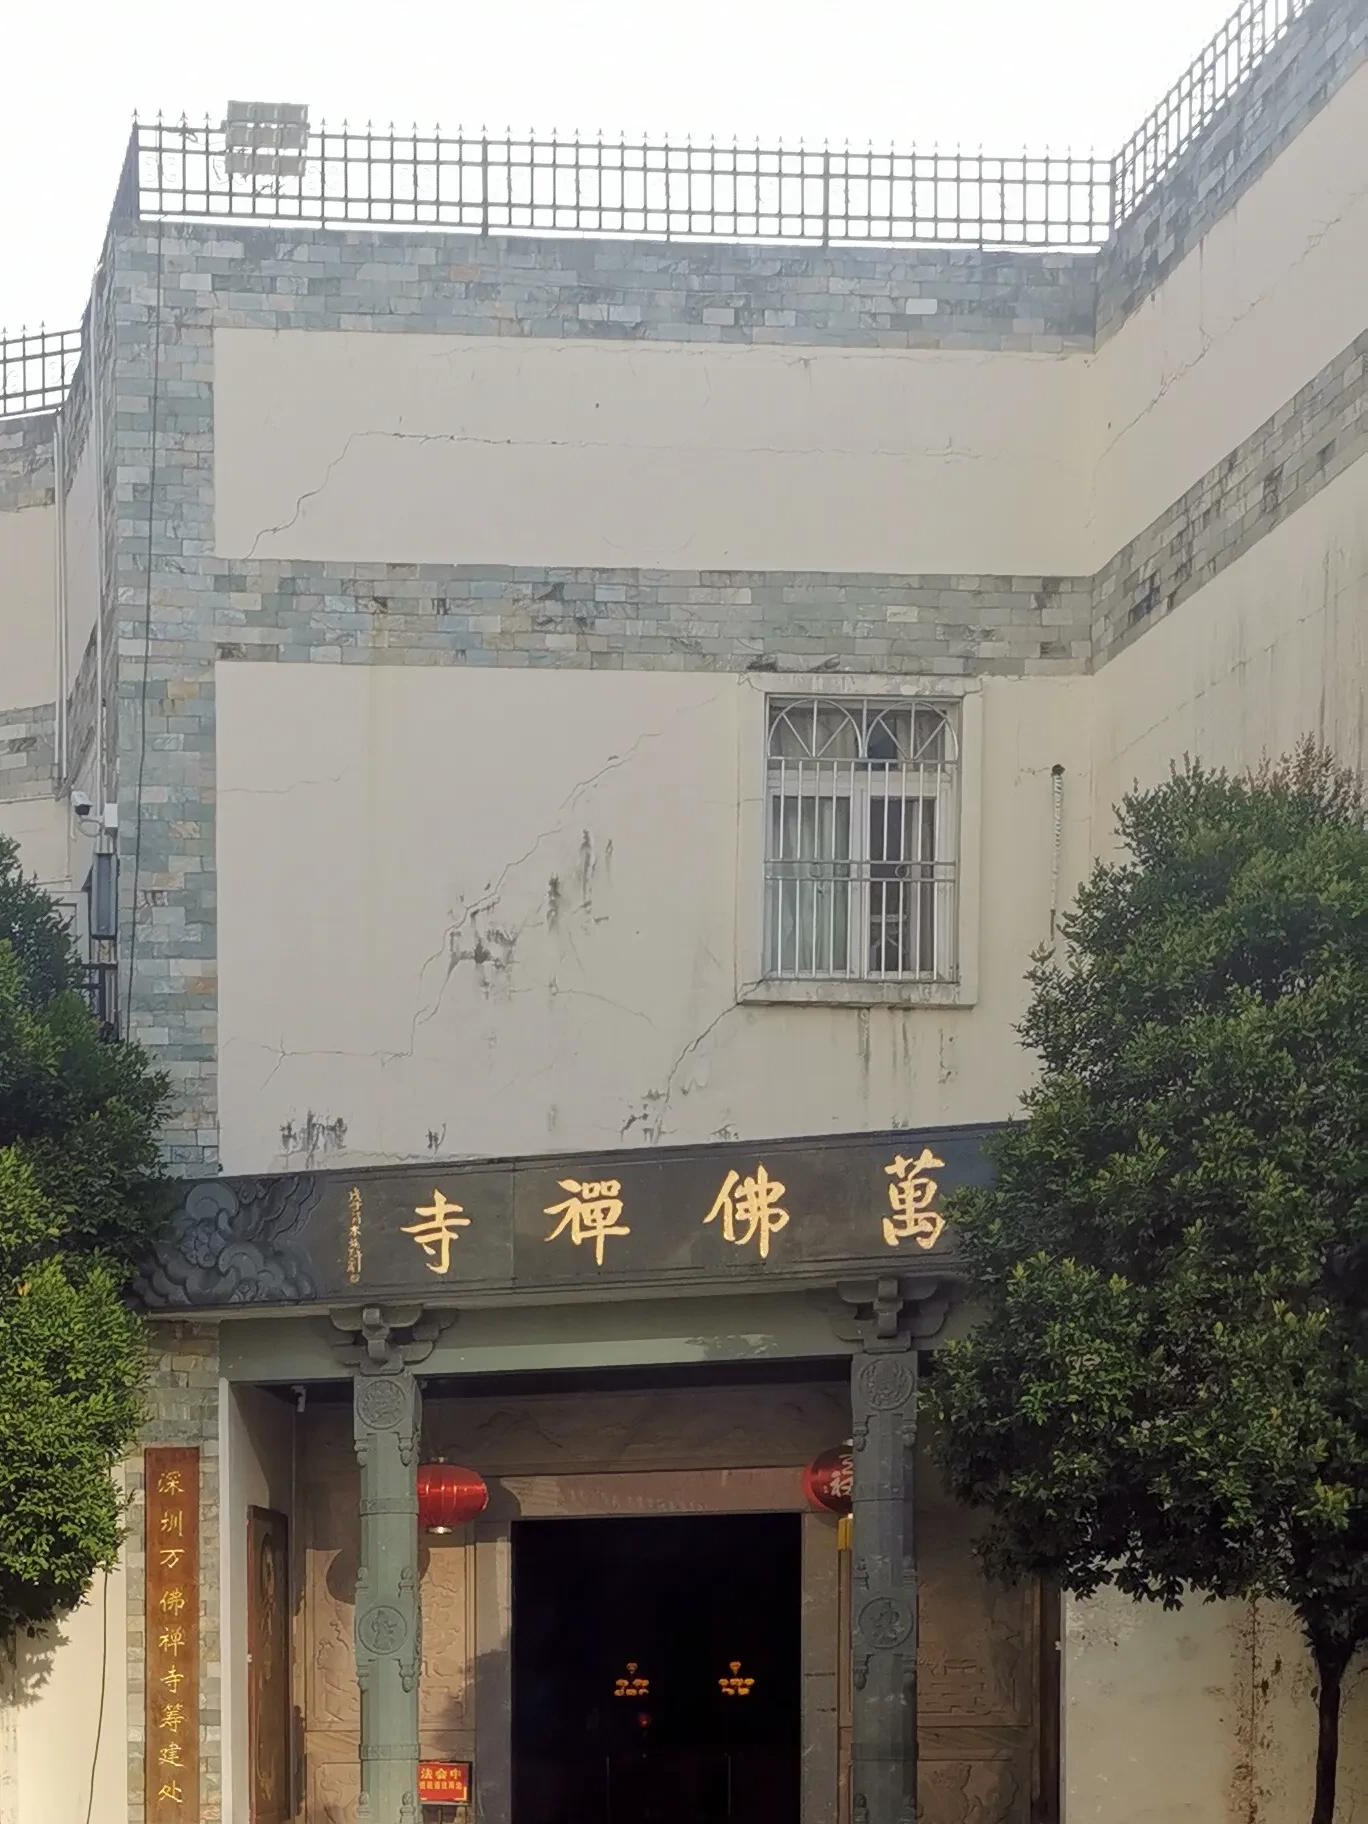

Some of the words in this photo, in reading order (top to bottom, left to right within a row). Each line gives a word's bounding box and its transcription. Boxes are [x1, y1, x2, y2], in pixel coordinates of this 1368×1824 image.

[400, 1148, 947, 1275] 萬佛禪寺
[157, 1471, 185, 1804] 深圳万佛禅寺筹建处
